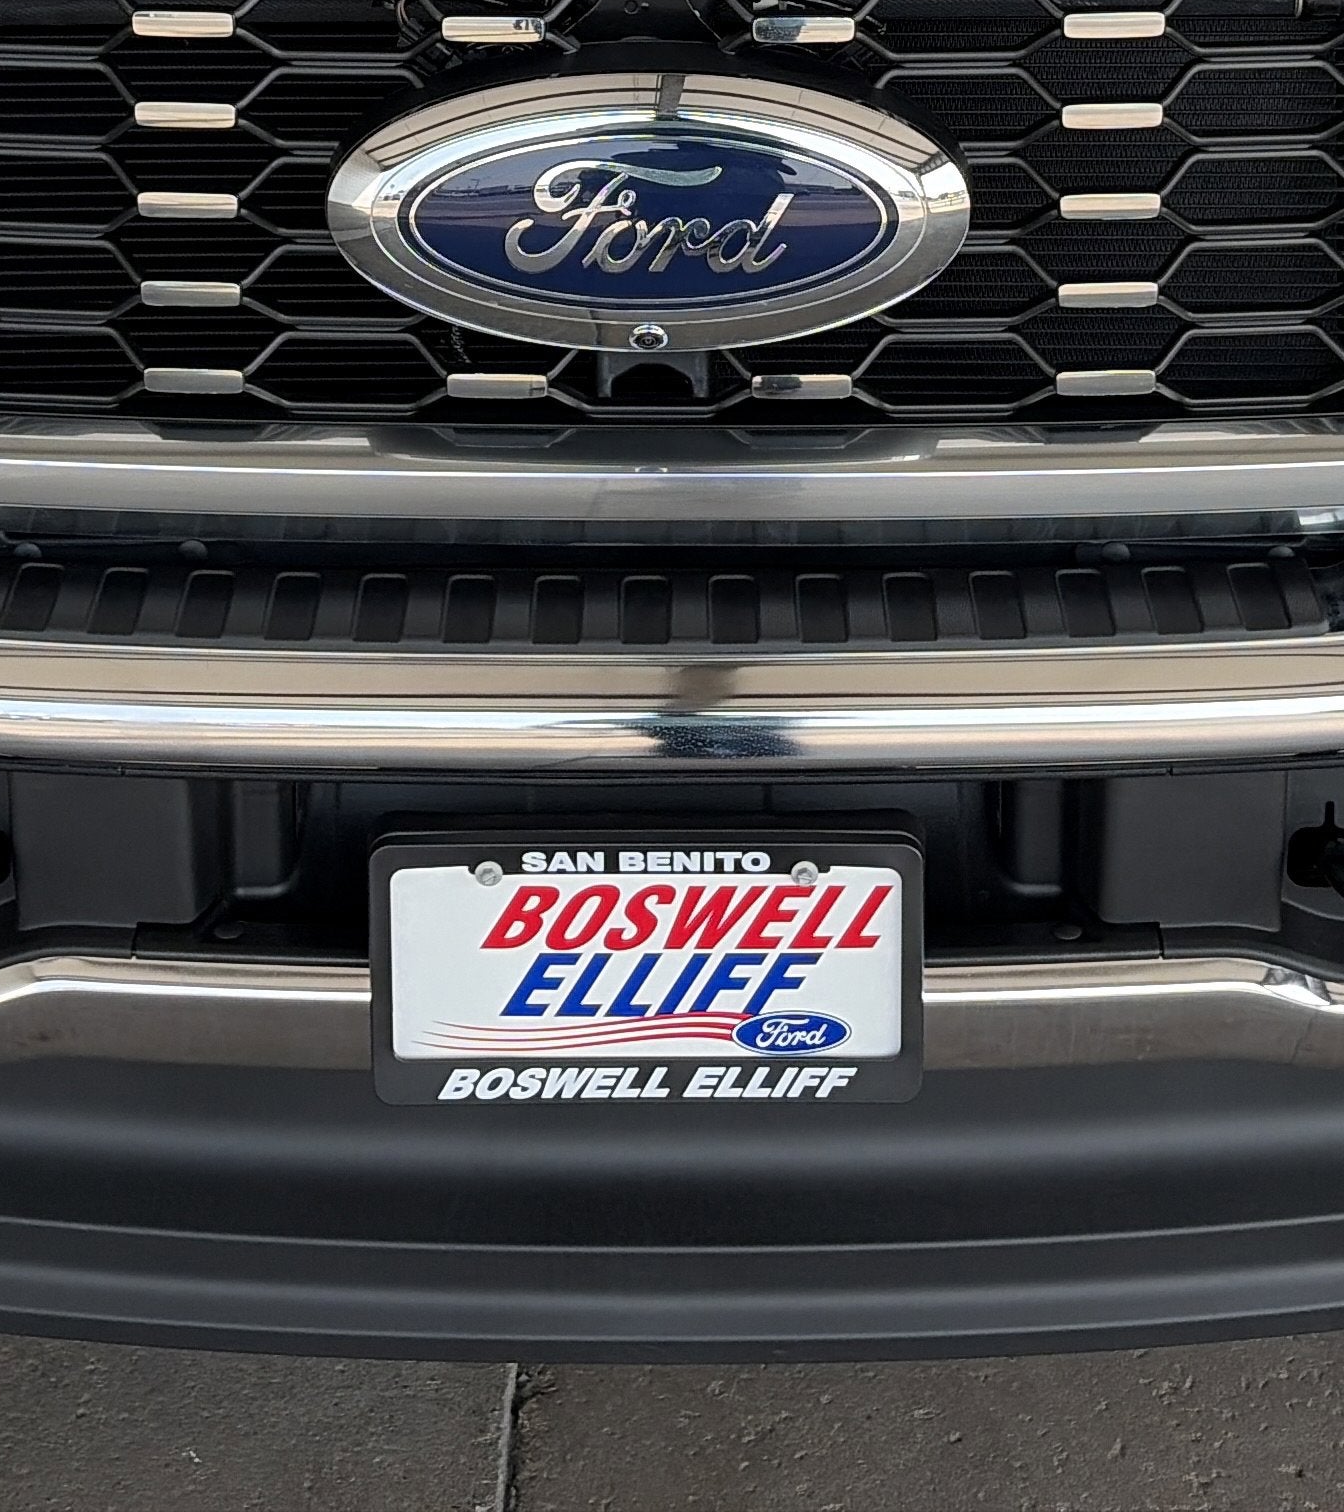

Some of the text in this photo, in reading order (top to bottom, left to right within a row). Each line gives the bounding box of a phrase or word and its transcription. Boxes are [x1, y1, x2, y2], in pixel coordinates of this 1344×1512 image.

[503, 158, 788, 275] Ford
[522, 851, 772, 873] SAN BENITO
[480, 884, 894, 951] BOSWELL
[499, 952, 825, 1018] ELLIFF
[754, 1018, 827, 1050] Ford
[437, 1067, 858, 1101] BOSWELL ELLIFF
